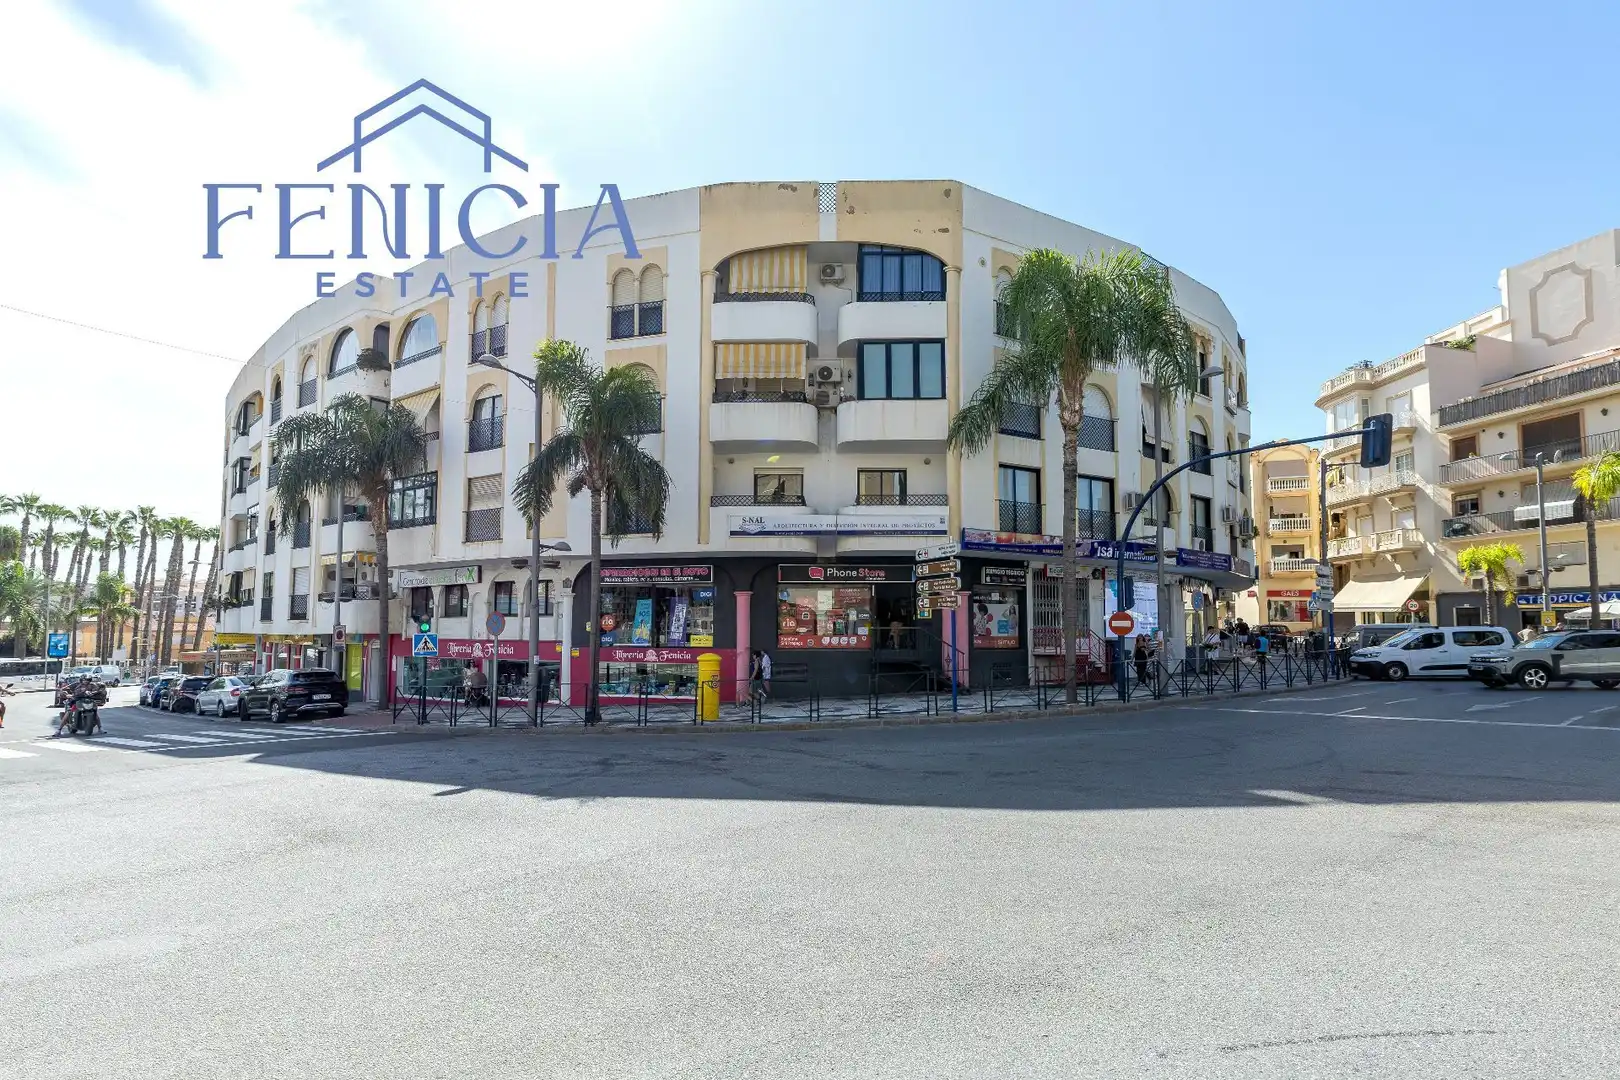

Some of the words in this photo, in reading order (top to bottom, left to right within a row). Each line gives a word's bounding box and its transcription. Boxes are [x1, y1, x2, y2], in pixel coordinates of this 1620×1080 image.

[1114, 548, 1155, 561] inernational
[827, 567, 857, 577] Phone
[858, 567, 886, 577] Store
[484, 643, 514, 657] Fnicia
[660, 650, 691, 661] Fenicia
